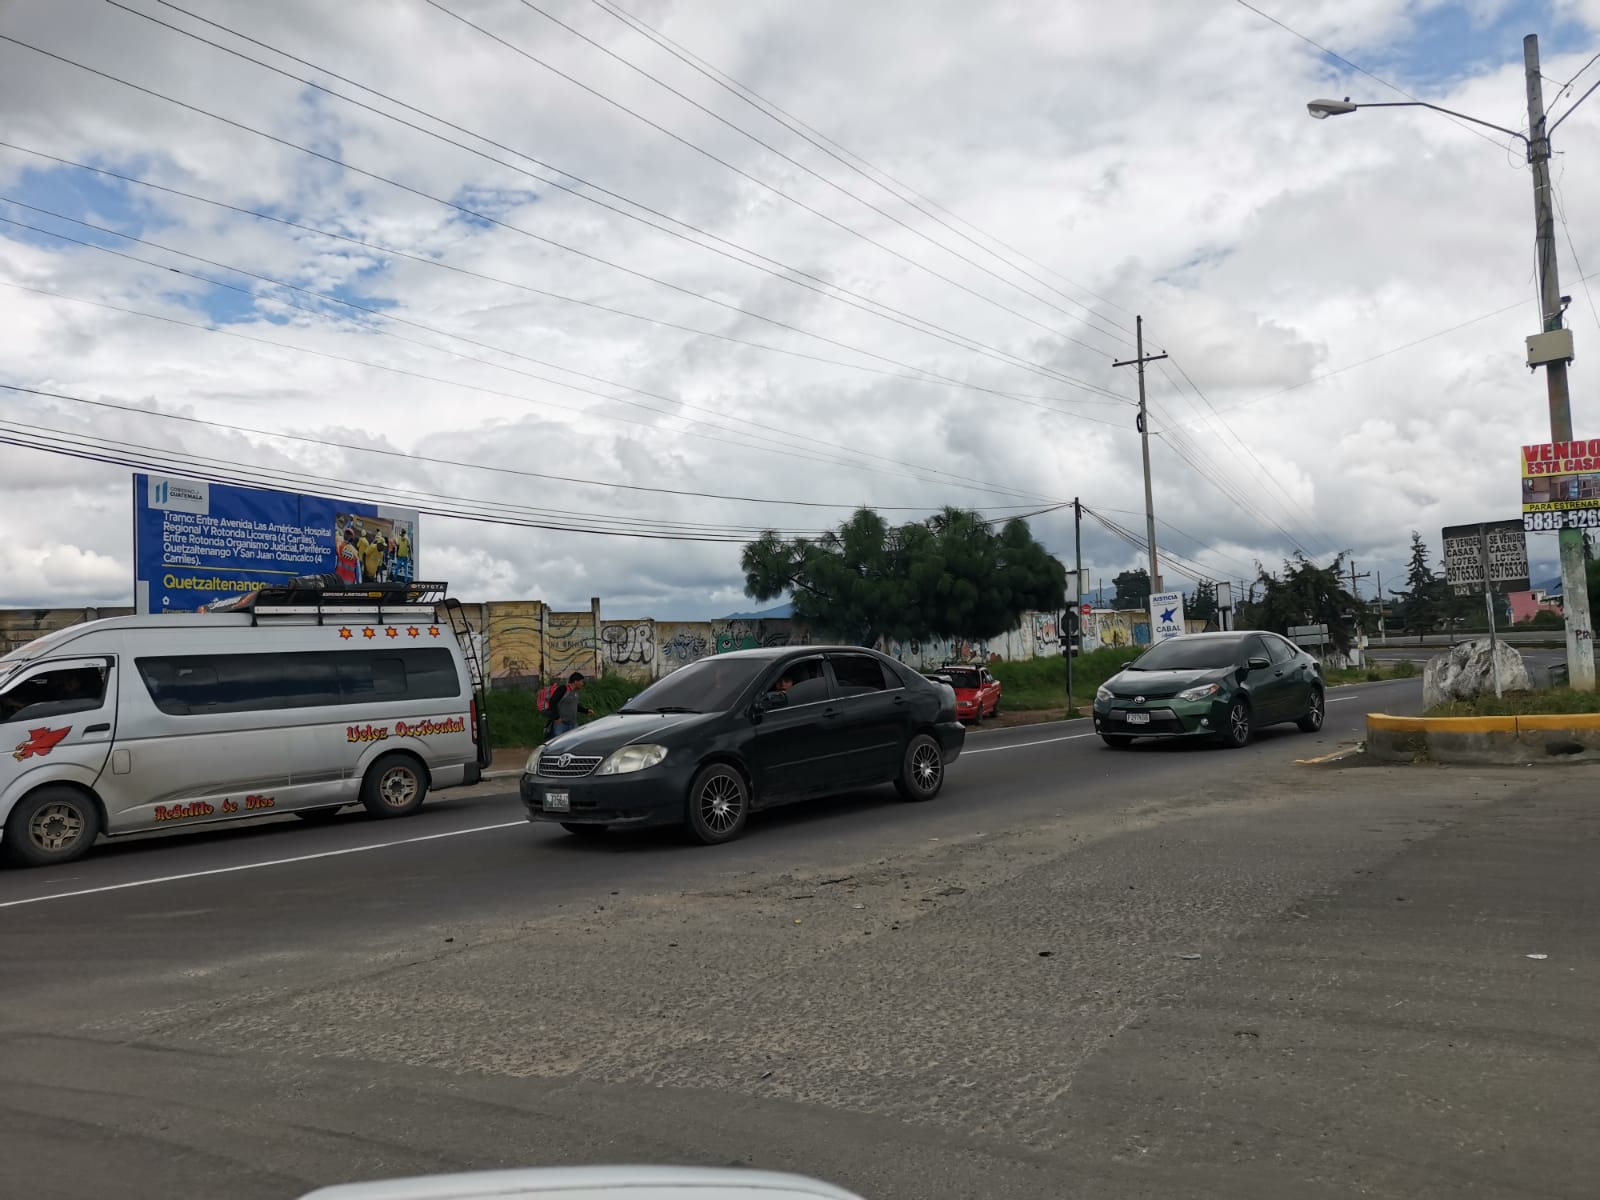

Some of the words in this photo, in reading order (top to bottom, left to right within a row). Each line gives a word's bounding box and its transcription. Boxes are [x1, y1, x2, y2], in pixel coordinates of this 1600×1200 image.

[1522, 439, 1600, 462] VENDO
[1527, 461, 1561, 474] ESTA
[1564, 458, 1600, 471] CASA
[170, 492, 203, 500] GUATEMALA
[1529, 503, 1552, 511] PARA
[1554, 500, 1598, 510] ESTRENAR
[163, 511, 195, 523] Tramo:
[196, 515, 219, 526] Entre
[220, 518, 253, 529] Avenida
[254, 521, 267, 531] Las
[304, 526, 331, 537] Hospital
[1523, 509, 1600, 531] 5835-526
[163, 521, 201, 534] Regional
[203, 525, 210, 535] Y
[210, 526, 245, 539] Rotonda
[247, 530, 277, 541] Licorera
[278, 533, 286, 543] (4
[1489, 535, 1498, 544] SE
[163, 532, 187, 543] Entre
[189, 534, 225, 547] Rotonda
[226, 537, 269, 551] Organismo
[1446, 539, 1455, 549] SE
[1456, 537, 1482, 548] VENDEN
[1489, 543, 1518, 553] CASAS
[1520, 542, 1526, 551] Y
[163, 542, 231, 558] Quetzaltenango
[233, 547, 240, 557] Y
[240, 549, 255, 558] San
[256, 550, 275, 560] Juan
[276, 551, 314, 562] Ostuncalco
[1446, 547, 1474, 557] CASAS
[1476, 547, 1482, 555] Y
[1495, 552, 1521, 562] LOTES
[1452, 556, 1478, 566] LOTES
[1447, 565, 1485, 582] 59765330
[1490, 561, 1528, 578] 59765330
[1156, 625, 1181, 633] CABAL
[346, 724, 389, 742] Veloz
[395, 716, 465, 737] Occidental
[245, 794, 275, 811] Dios
